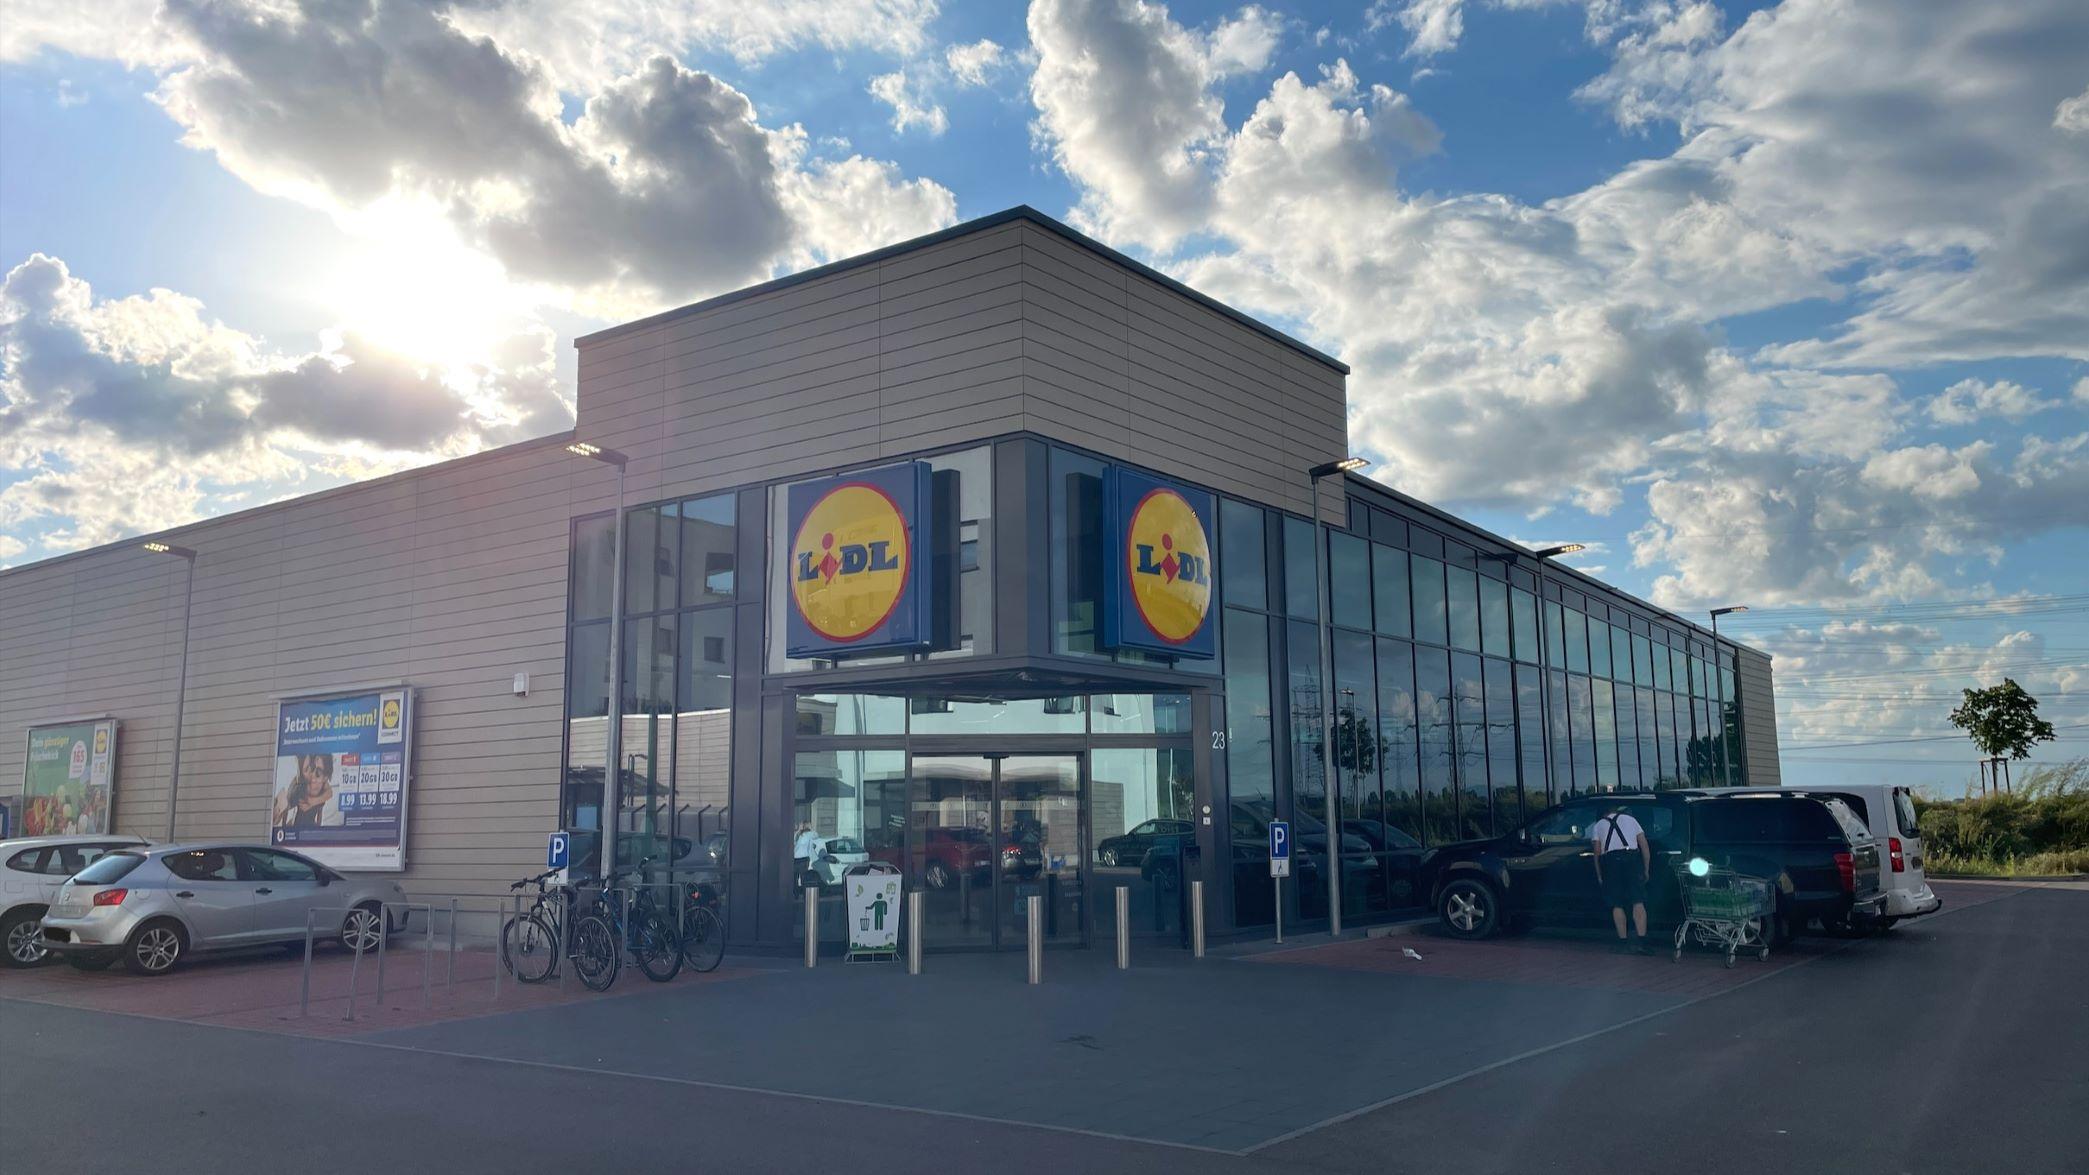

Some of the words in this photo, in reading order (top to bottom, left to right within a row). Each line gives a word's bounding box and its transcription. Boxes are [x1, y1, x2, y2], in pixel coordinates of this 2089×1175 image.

[284, 716, 309, 733] Jetzt
[311, 712, 332, 731] 50€
[333, 708, 377, 729] sichern!
[1212, 731, 1226, 750] 23
[342, 773, 349, 785] 10
[360, 772, 369, 784] 20
[381, 771, 390, 783] 30
[1274, 827, 1285, 854] P
[552, 837, 565, 864] P
